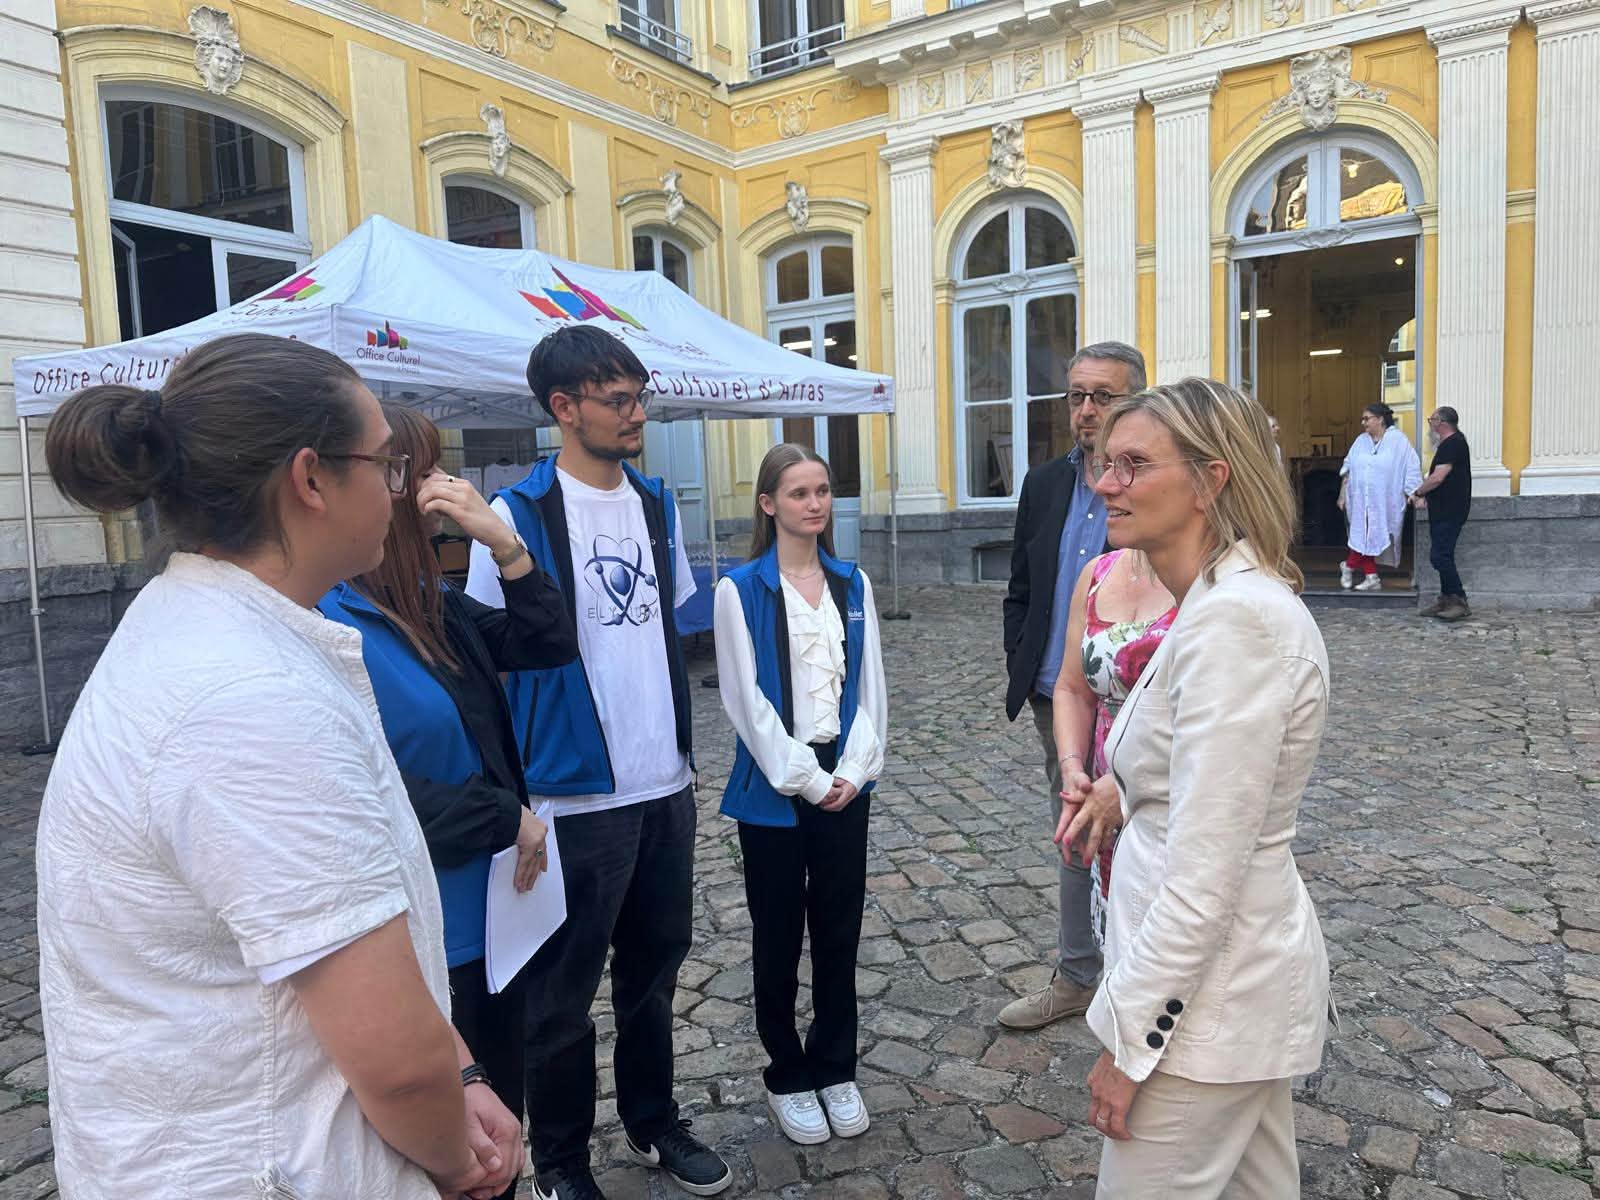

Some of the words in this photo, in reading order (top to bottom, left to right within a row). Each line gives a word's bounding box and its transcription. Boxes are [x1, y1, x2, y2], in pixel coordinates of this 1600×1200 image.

[356, 347, 385, 361] Office
[386, 351, 421, 366] Culturel
[33, 367, 90, 395] Office
[100, 347, 189, 385] Cultur
[650, 370, 751, 401] Culturel
[587, 607, 659, 619] ELYIUM
